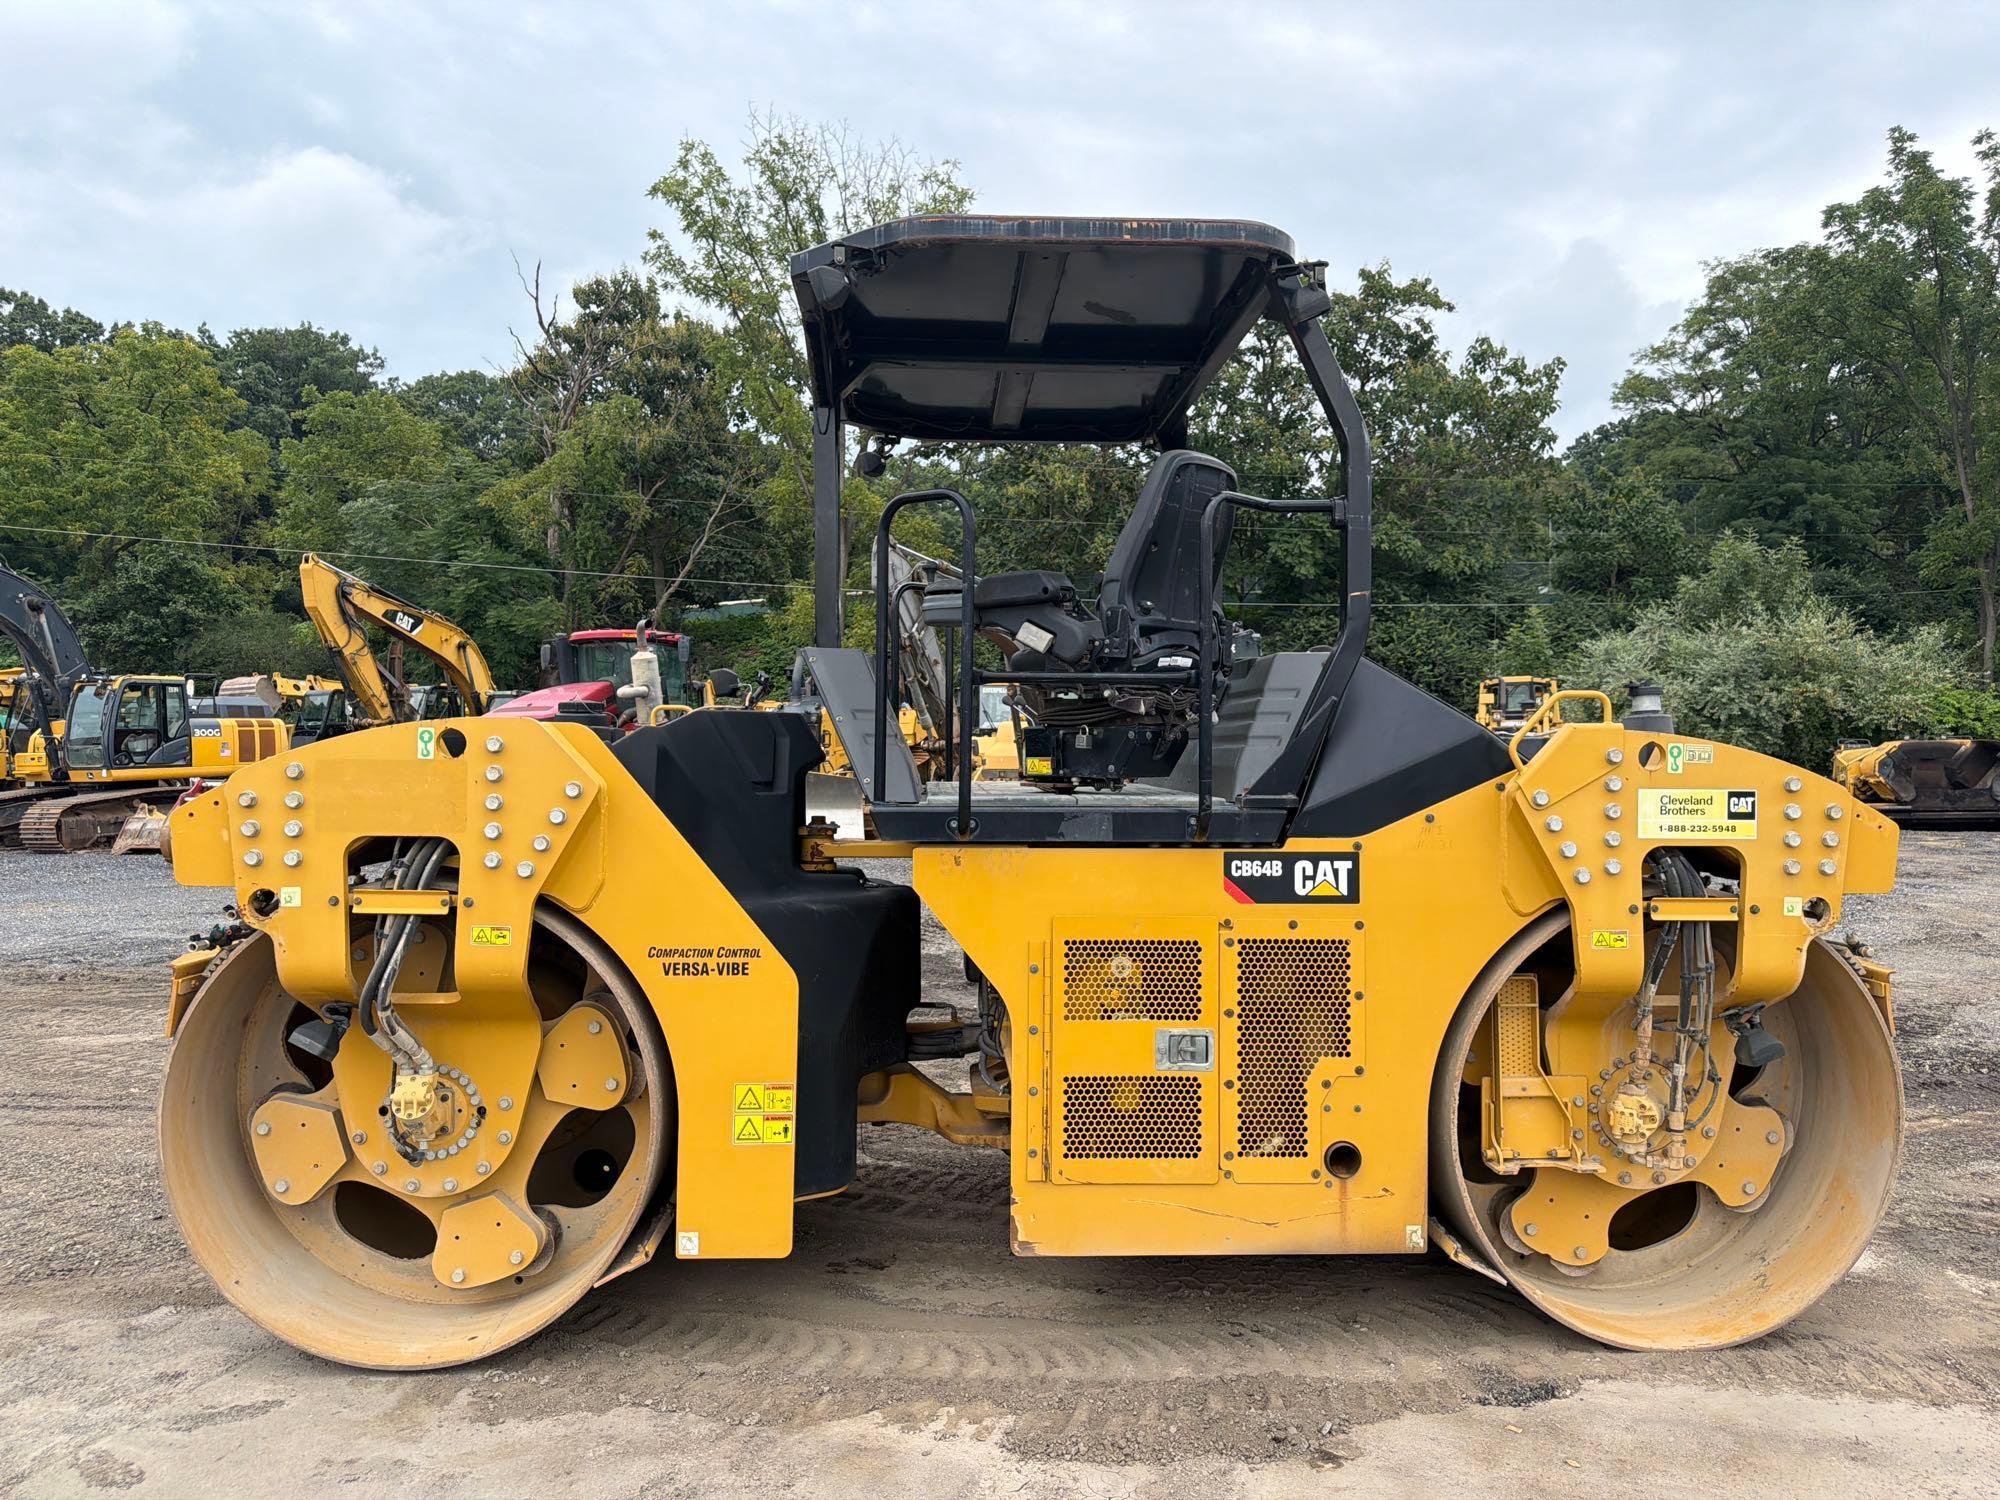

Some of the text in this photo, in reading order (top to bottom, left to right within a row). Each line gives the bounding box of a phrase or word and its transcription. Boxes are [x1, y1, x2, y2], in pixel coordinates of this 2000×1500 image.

[395, 611, 415, 631] CAT
[193, 728, 221, 737] 300G
[1659, 795, 1713, 806] Cleveland
[1729, 797, 1755, 813] CAT
[1659, 805, 1706, 815] Brothers
[1658, 824, 1737, 833] 1-888-232-5948
[1230, 860, 1352, 896] CB64B CAT
[647, 946, 761, 958] COMPACTION CONTROL
[662, 962, 750, 976] VERSA-VIBE
